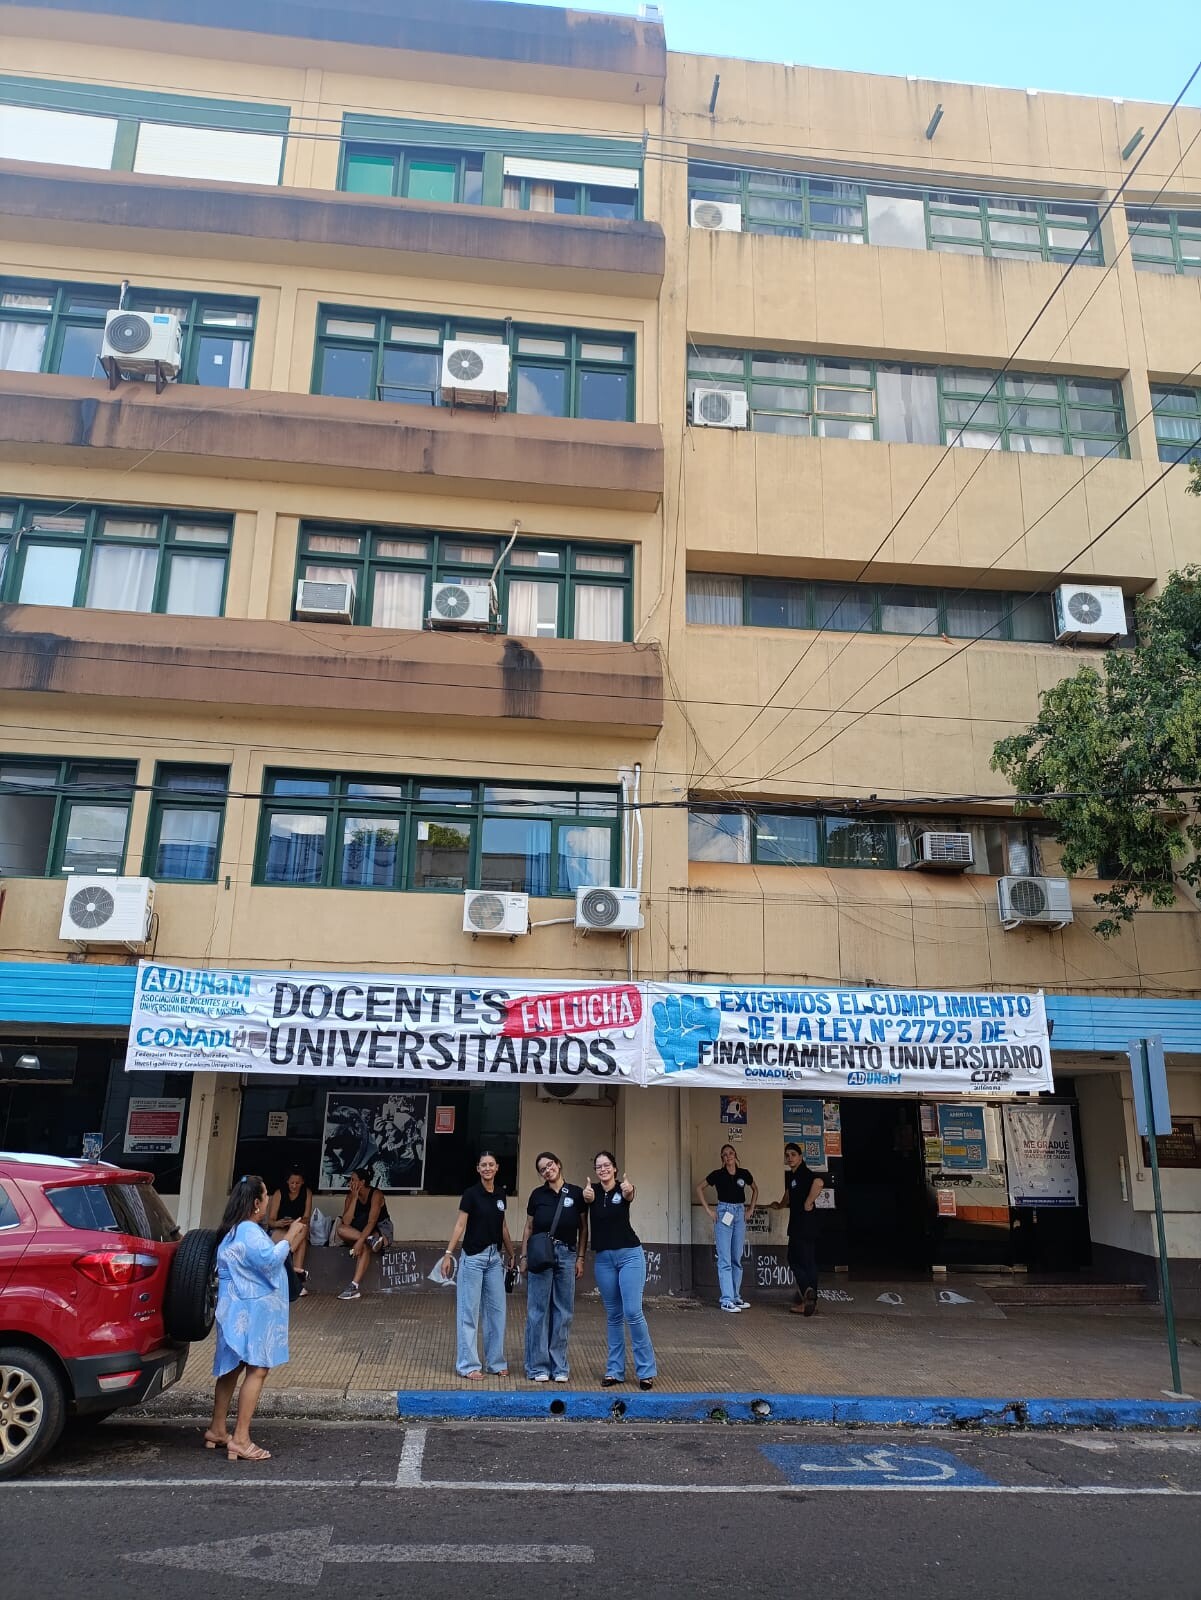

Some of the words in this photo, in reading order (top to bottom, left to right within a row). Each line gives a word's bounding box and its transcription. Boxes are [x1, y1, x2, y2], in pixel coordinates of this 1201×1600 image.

[141, 966, 251, 997] ADUNaM
[273, 981, 511, 1024] DOCENTES
[521, 1000, 553, 1033] EN
[559, 992, 635, 1030] LUCHA
[720, 990, 831, 1014] EXIGIMOS
[837, 993, 863, 1015] EL
[869, 993, 1031, 1018] CUMPLIMIENTO
[747, 1015, 774, 1040] DE
[781, 1017, 813, 1041] LA
[817, 1018, 863, 1042] LEY
[895, 1019, 973, 1044] 27795
[981, 1020, 1009, 1044] DE
[269, 1027, 616, 1076] UNIVERSITARIOS
[698, 1041, 882, 1069] FINANCIAMIENTO
[889, 1044, 1043, 1070] UNIVERSITARIO
[847, 1071, 902, 1085] ADUNaM
[1023, 1140, 1036, 1149] ME
[382, 1251, 416, 1266] FUERA
[757, 1255, 778, 1267] SON
